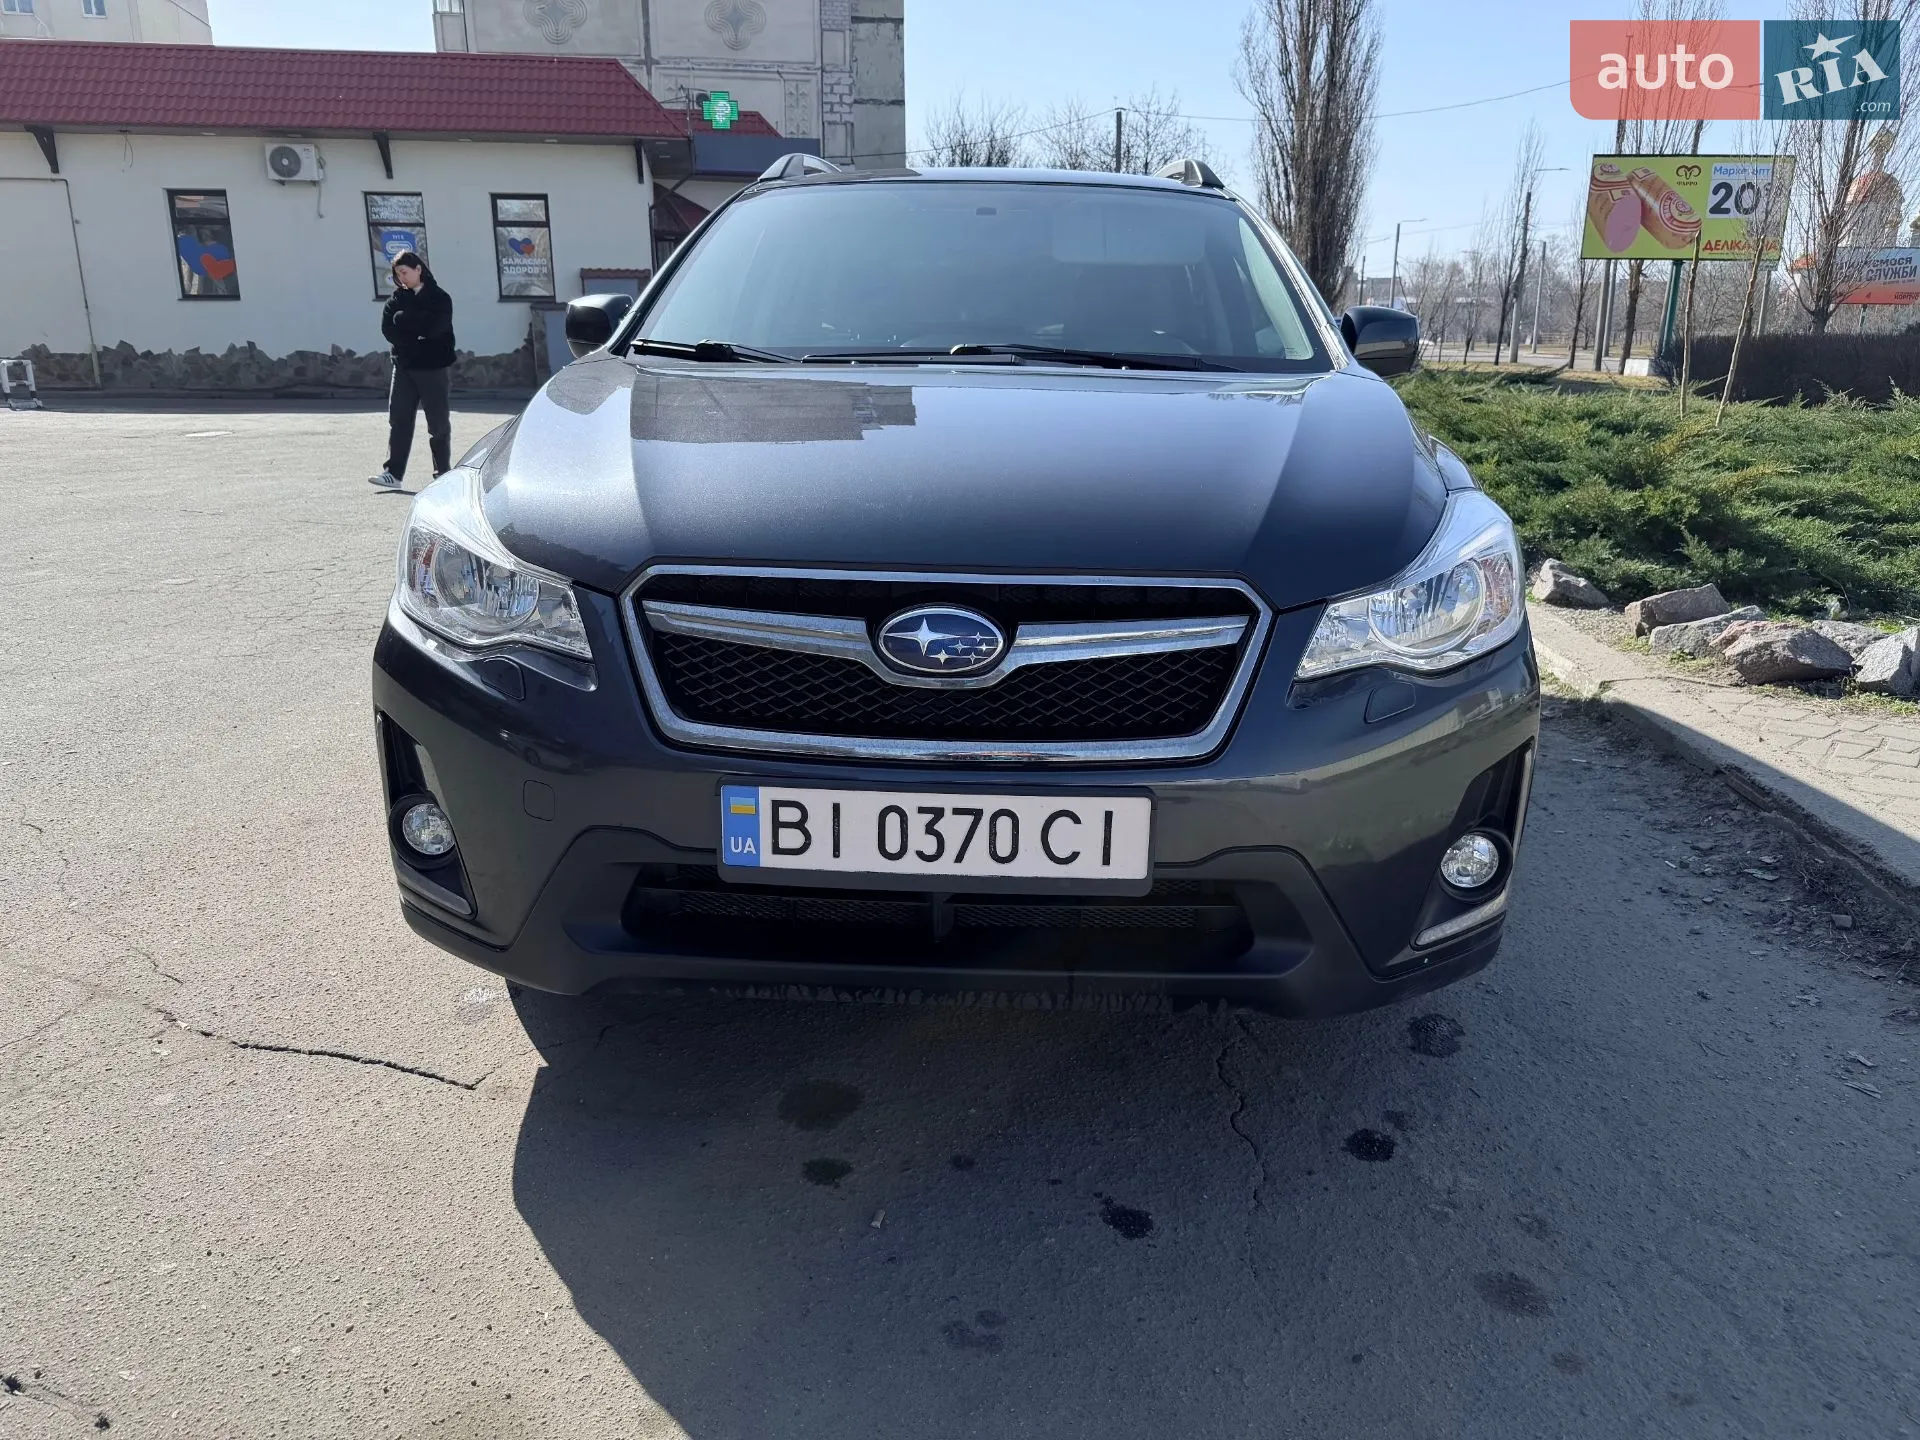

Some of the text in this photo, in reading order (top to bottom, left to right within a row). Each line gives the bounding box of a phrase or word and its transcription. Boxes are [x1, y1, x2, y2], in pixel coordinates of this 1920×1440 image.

[1865, 265, 1918, 281] СЛУЖБИ
[771, 799, 1114, 866] BI 0370 CI
[730, 837, 757, 855] UA
